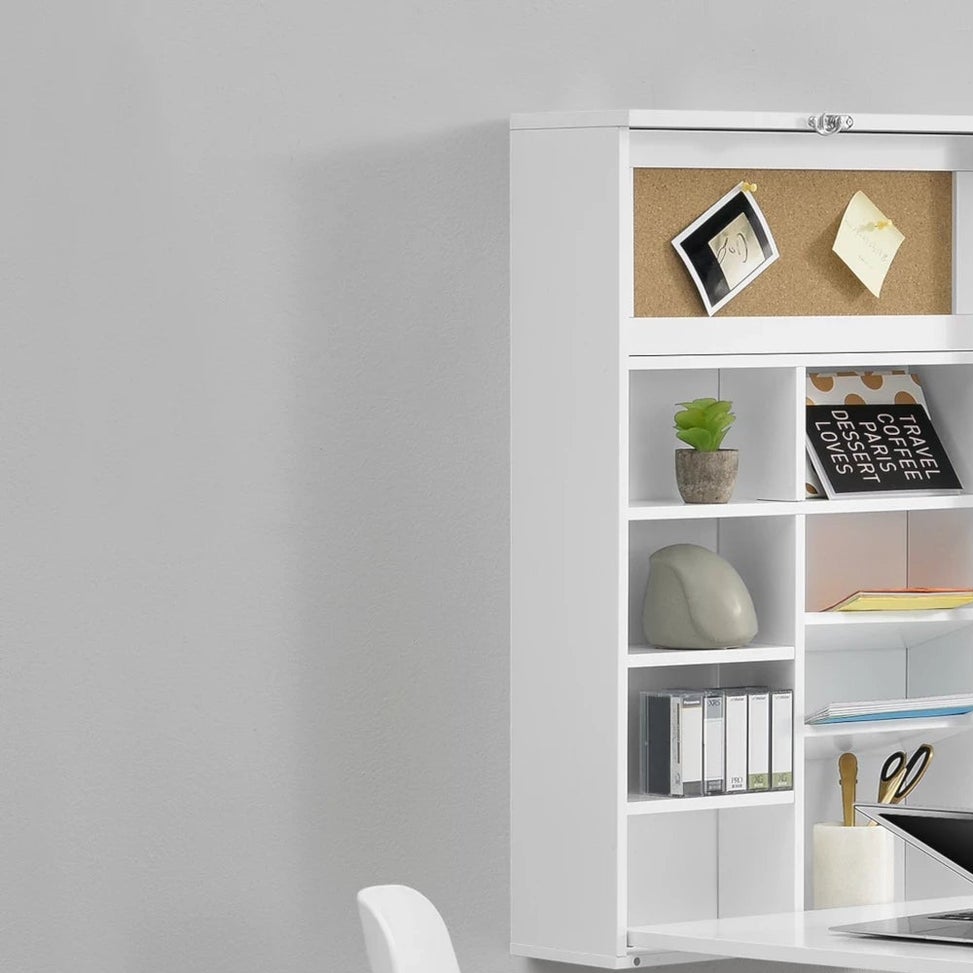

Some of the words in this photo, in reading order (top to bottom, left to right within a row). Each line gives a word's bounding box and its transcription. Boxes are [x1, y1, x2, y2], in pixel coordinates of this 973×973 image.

[815, 421, 854, 475] LOVES
[831, 410, 881, 483] DESSERT
[859, 421, 897, 473] PARIS
[877, 413, 923, 480] COFFEE
[899, 414, 941, 480] TRAVEL
